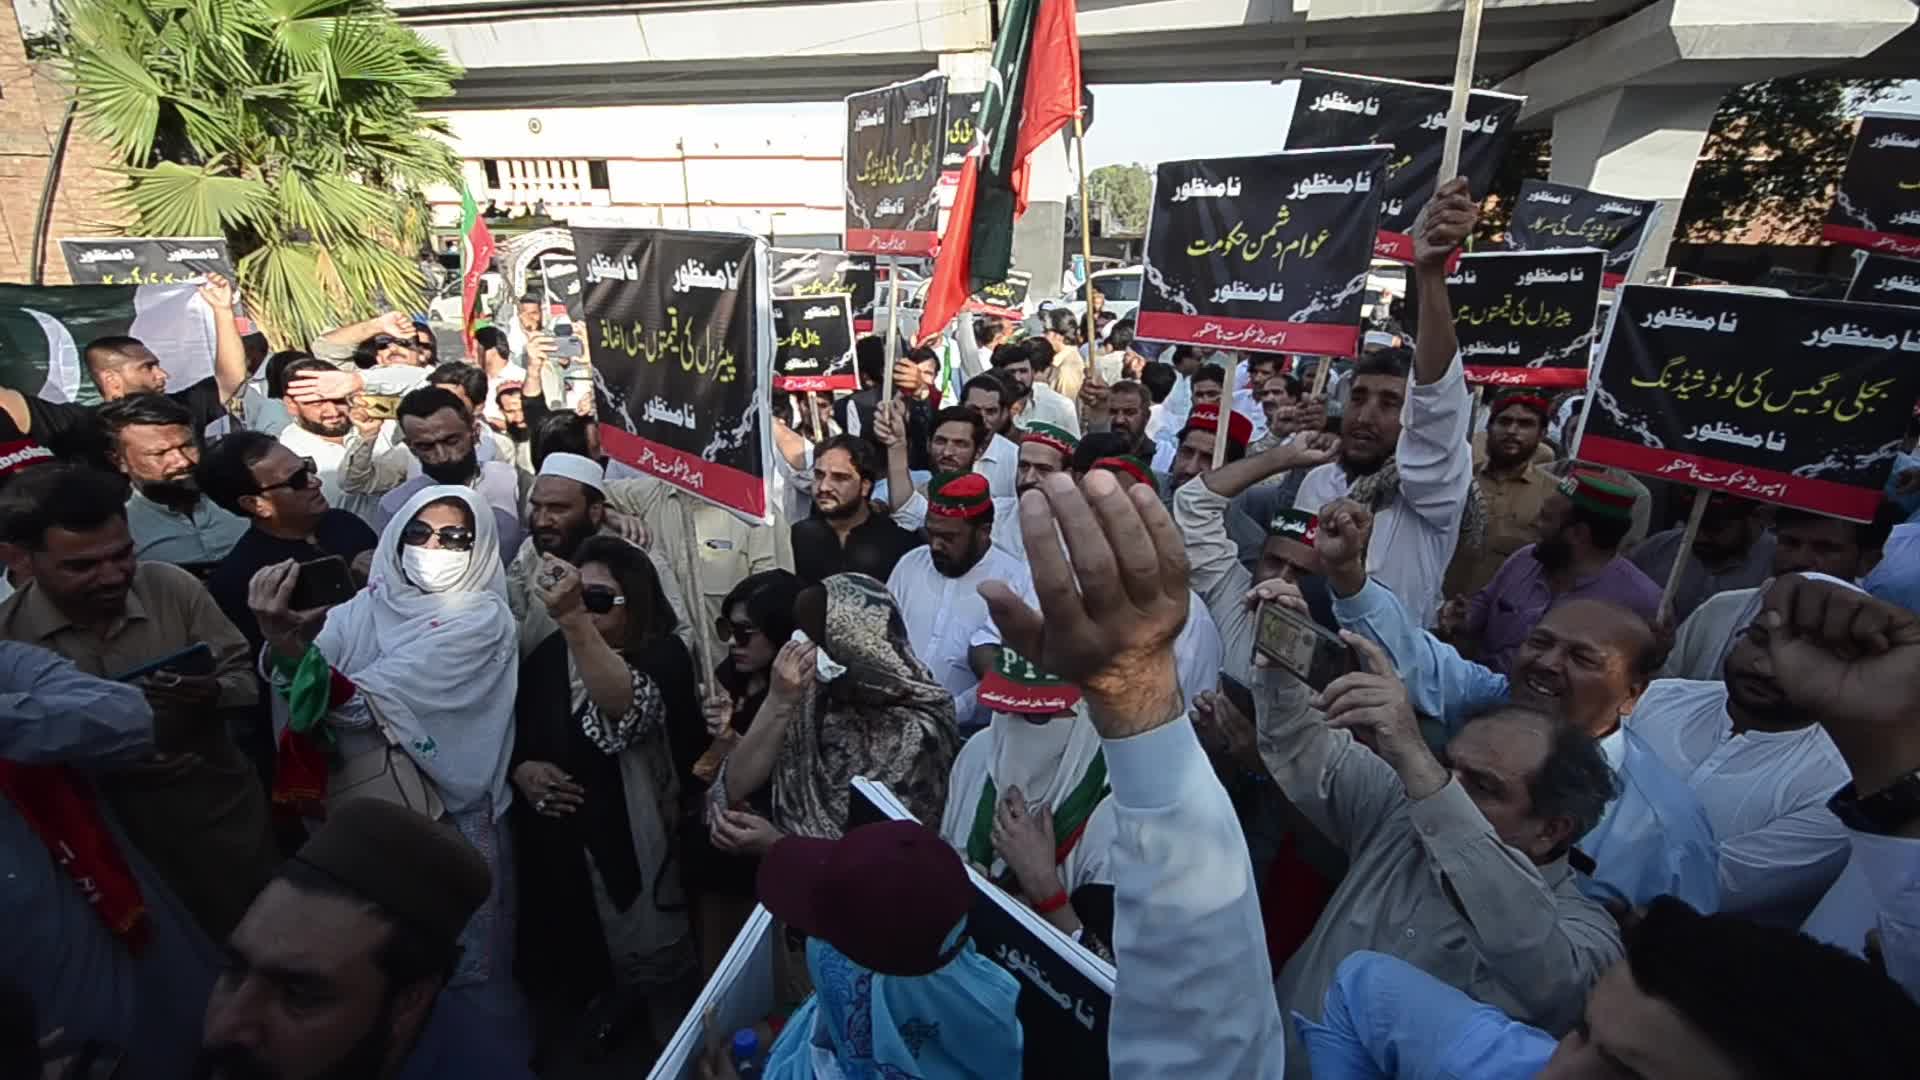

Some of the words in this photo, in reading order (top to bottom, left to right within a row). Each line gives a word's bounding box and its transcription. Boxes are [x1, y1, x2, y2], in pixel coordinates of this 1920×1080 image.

[1309, 90, 1380, 115] نامنظور
[1171, 177, 1242, 202] نامنظور
[1286, 171, 1372, 200] نامنظور
[1526, 190, 1572, 204] نامنظور
[1187, 220, 1248, 257] حکومت
[1242, 204, 1290, 262] دشمن
[1279, 229, 1330, 273] عوام
[586, 254, 639, 283] نامنظور
[673, 258, 739, 292] نامنظور
[1515, 267, 1584, 286] نامنظور
[1210, 280, 1284, 304] نامنظور
[1639, 307, 1738, 333] نامنظور
[680, 316, 694, 371] کی
[696, 325, 737, 382] پیٹرول
[1461, 341, 1521, 355] نامنظور
[1736, 367, 1773, 408] کی
[1763, 372, 1841, 413] گیس
[1834, 378, 1896, 422] بجلی
[643, 396, 696, 430] نامنظور
[1816, 399, 1832, 414] و
[1683, 421, 1786, 452] نامنظور
[1698, 469, 1746, 486] حکومت
[996, 943, 1096, 1030] نامنظور
